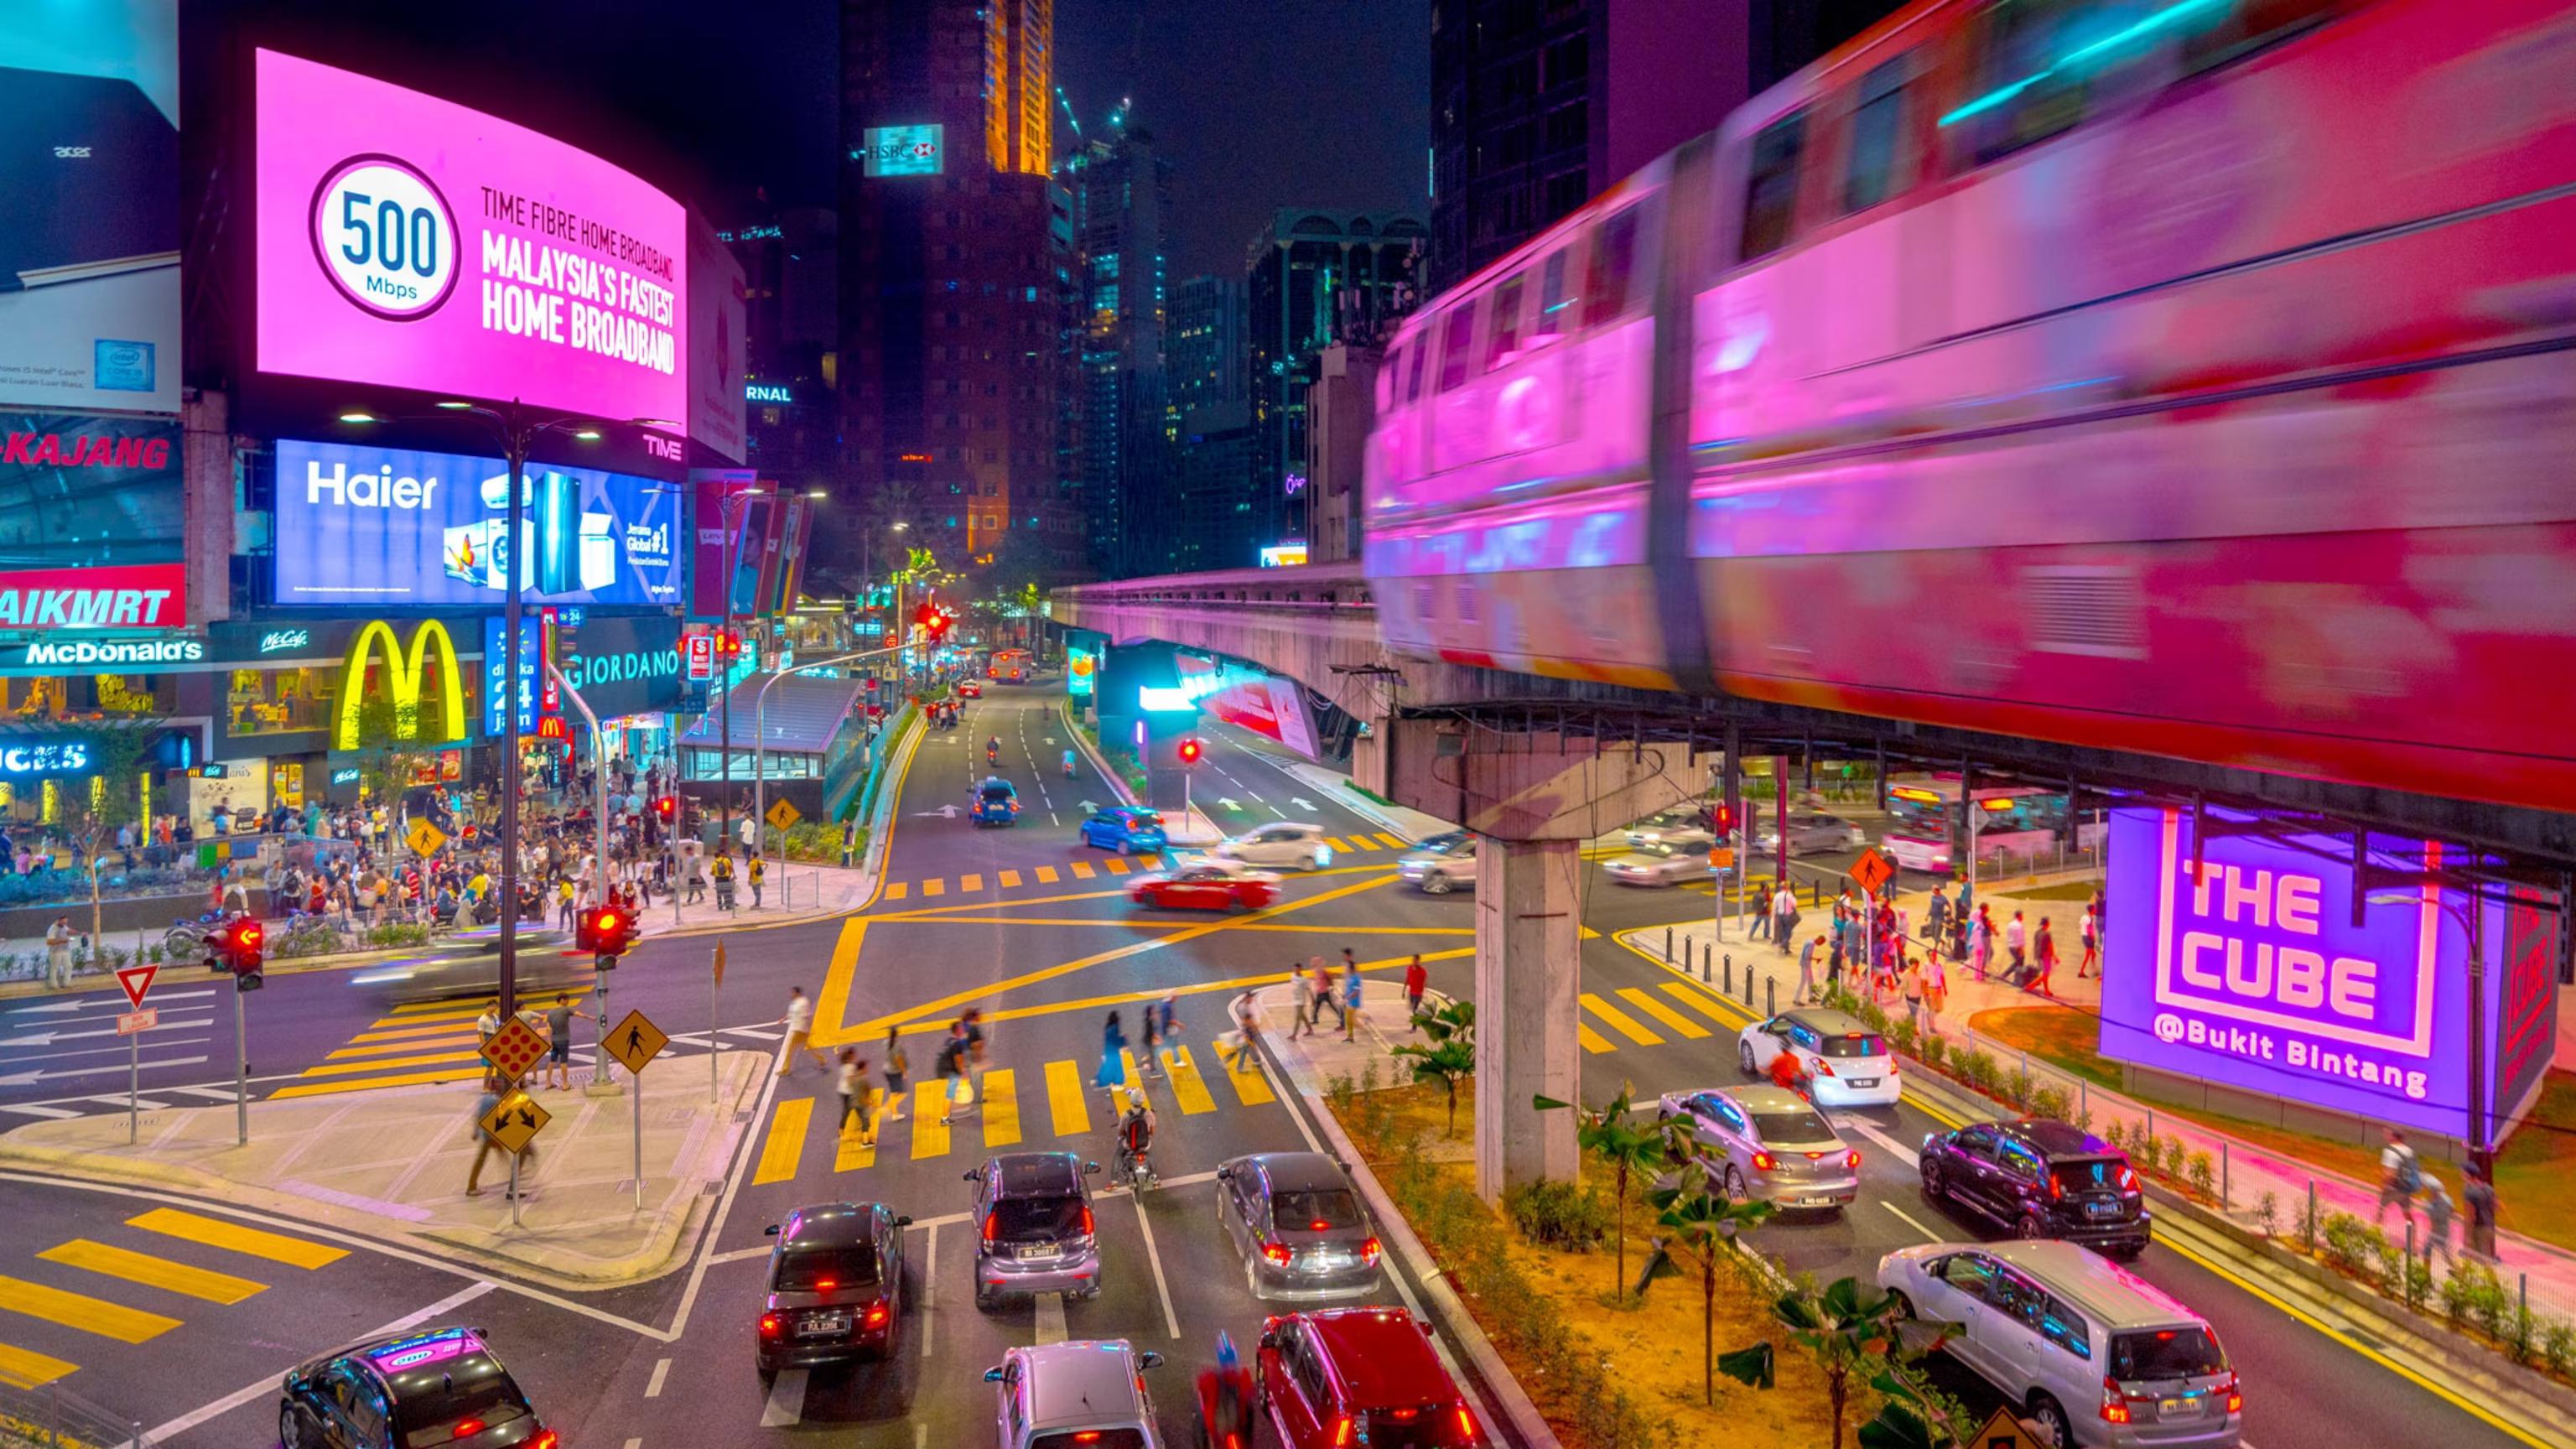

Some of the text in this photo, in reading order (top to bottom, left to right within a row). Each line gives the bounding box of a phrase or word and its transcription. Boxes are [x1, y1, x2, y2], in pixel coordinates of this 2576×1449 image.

[54, 147, 91, 158] acer
[868, 143, 911, 159] HSBC
[342, 190, 436, 278] 500
[481, 186, 673, 283] TIME FIBRE HOME BROADBAND
[366, 274, 418, 299] Mbps
[482, 229, 674, 329] MALAYSIA'S FASTEST
[482, 279, 675, 376] HOME BROADBAND
[745, 385, 792, 402] RNAL
[642, 434, 682, 461] TIME
[307, 460, 438, 510] Haier
[25, 641, 202, 664] McDonald's
[492, 662, 534, 677] dika
[564, 649, 679, 691] GIORDANO
[2184, 858, 2322, 936] THE
[2181, 930, 2377, 1021] CUBE
[2153, 1012, 2428, 1100] @Bukit Bintang
